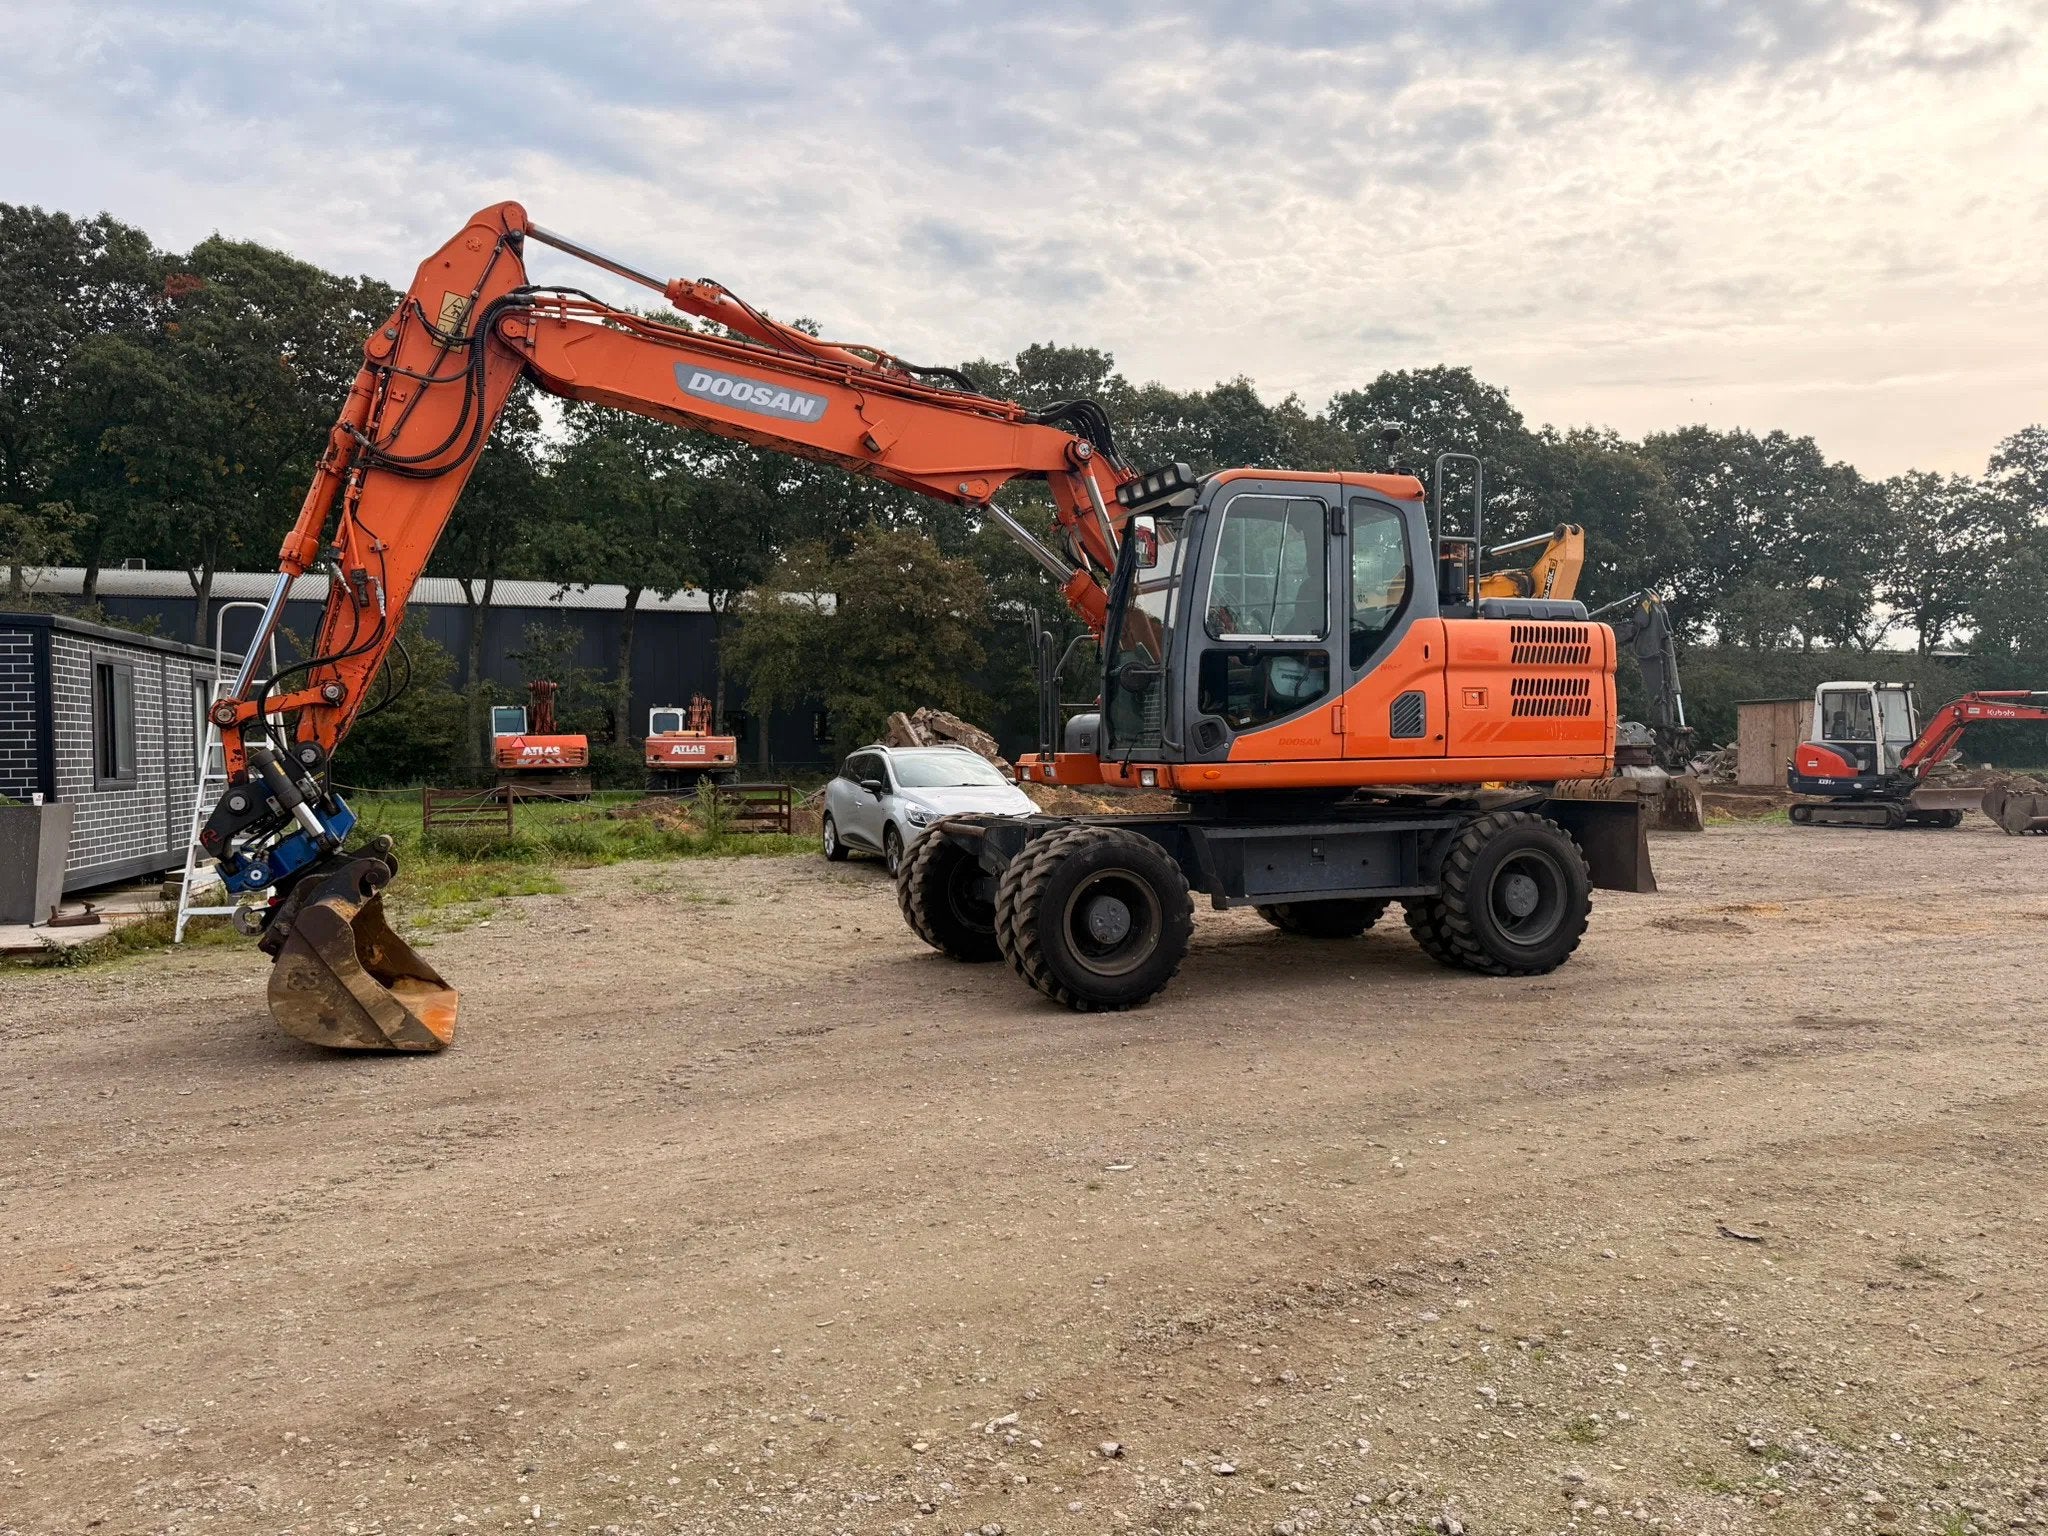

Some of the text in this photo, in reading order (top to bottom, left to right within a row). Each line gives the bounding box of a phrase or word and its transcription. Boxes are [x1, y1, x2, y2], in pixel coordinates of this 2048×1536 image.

[687, 372, 815, 416] DOOSAN
[1987, 708, 2015, 717] Kubota
[1278, 737, 1321, 746] DOOSAN
[522, 746, 561, 757] ATLAS
[671, 745, 706, 755] ATLAS
